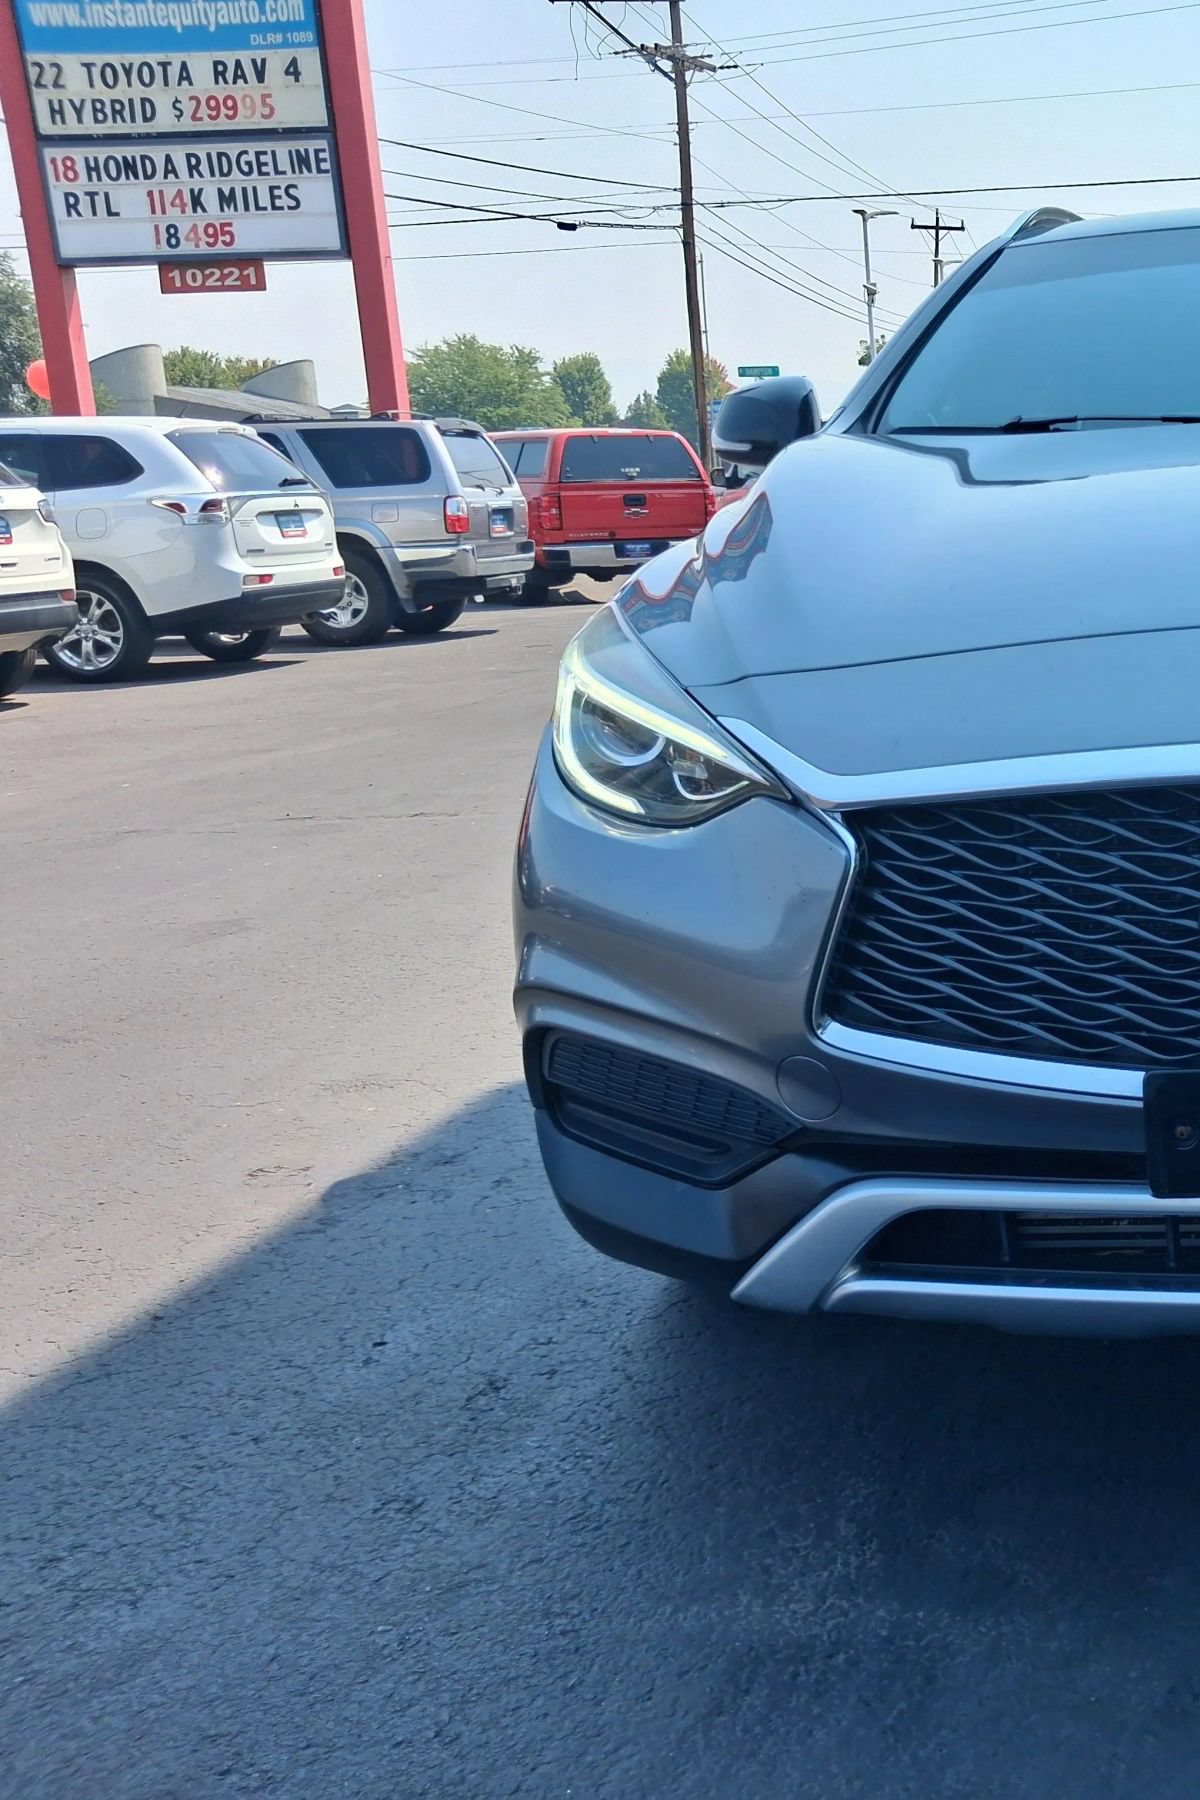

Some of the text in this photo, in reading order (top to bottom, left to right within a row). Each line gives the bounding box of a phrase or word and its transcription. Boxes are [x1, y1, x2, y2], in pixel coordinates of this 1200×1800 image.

[30, 0, 305, 33] www.instantequityauto.com
[251, 31, 313, 45] DLR# 1089
[31, 56, 301, 90] 22 TOYOTA RAV 4
[48, 93, 275, 125] HYBRID $29995
[50, 148, 330, 183] 18 HONDA RIDGELINE
[64, 184, 301, 217] RTL 114K MILES
[154, 222, 236, 249] 18495
[168, 266, 257, 287] 10221
